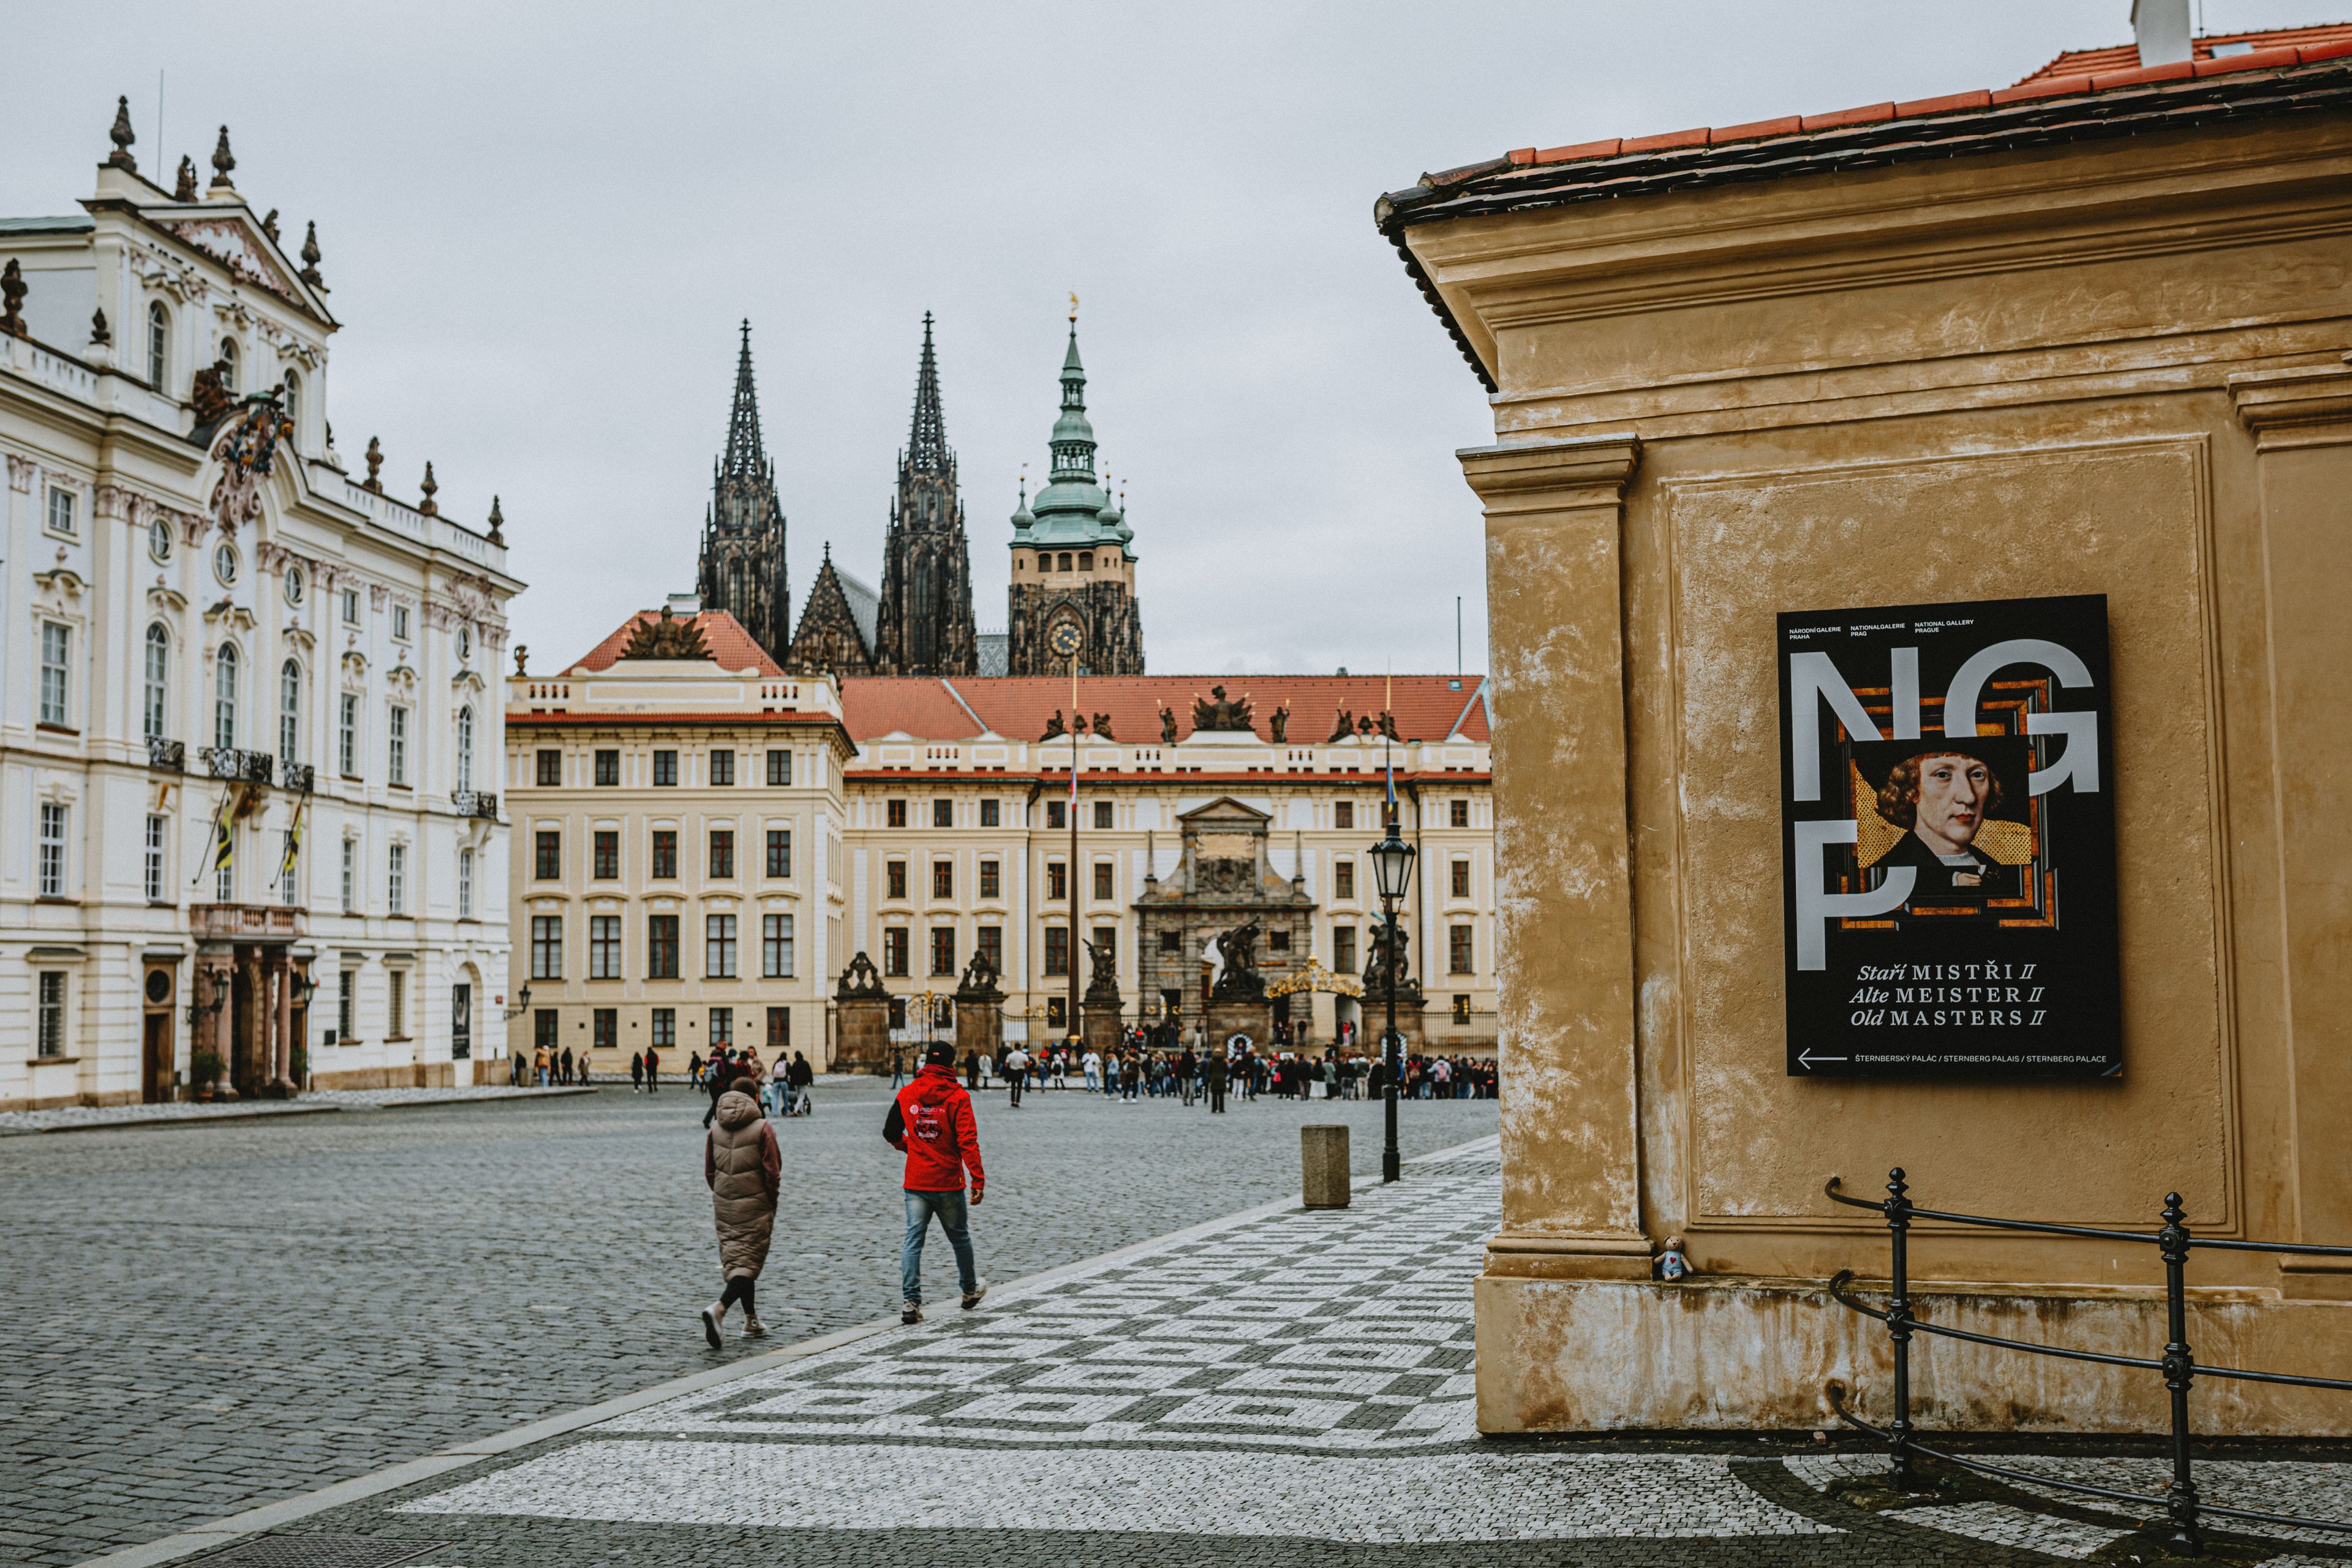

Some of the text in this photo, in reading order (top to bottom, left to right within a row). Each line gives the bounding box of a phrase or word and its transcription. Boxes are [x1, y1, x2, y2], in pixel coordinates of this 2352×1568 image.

[1856, 960, 2037, 981] Staří MISTŘI II
[1849, 986, 2045, 1003] Alte MEISTER II
[1851, 1009, 2047, 1026] Old MASTERS II
[1855, 1054, 1911, 1062] ŠTERNBERSKÝ
[1912, 1054, 1937, 1062] PALÁC
